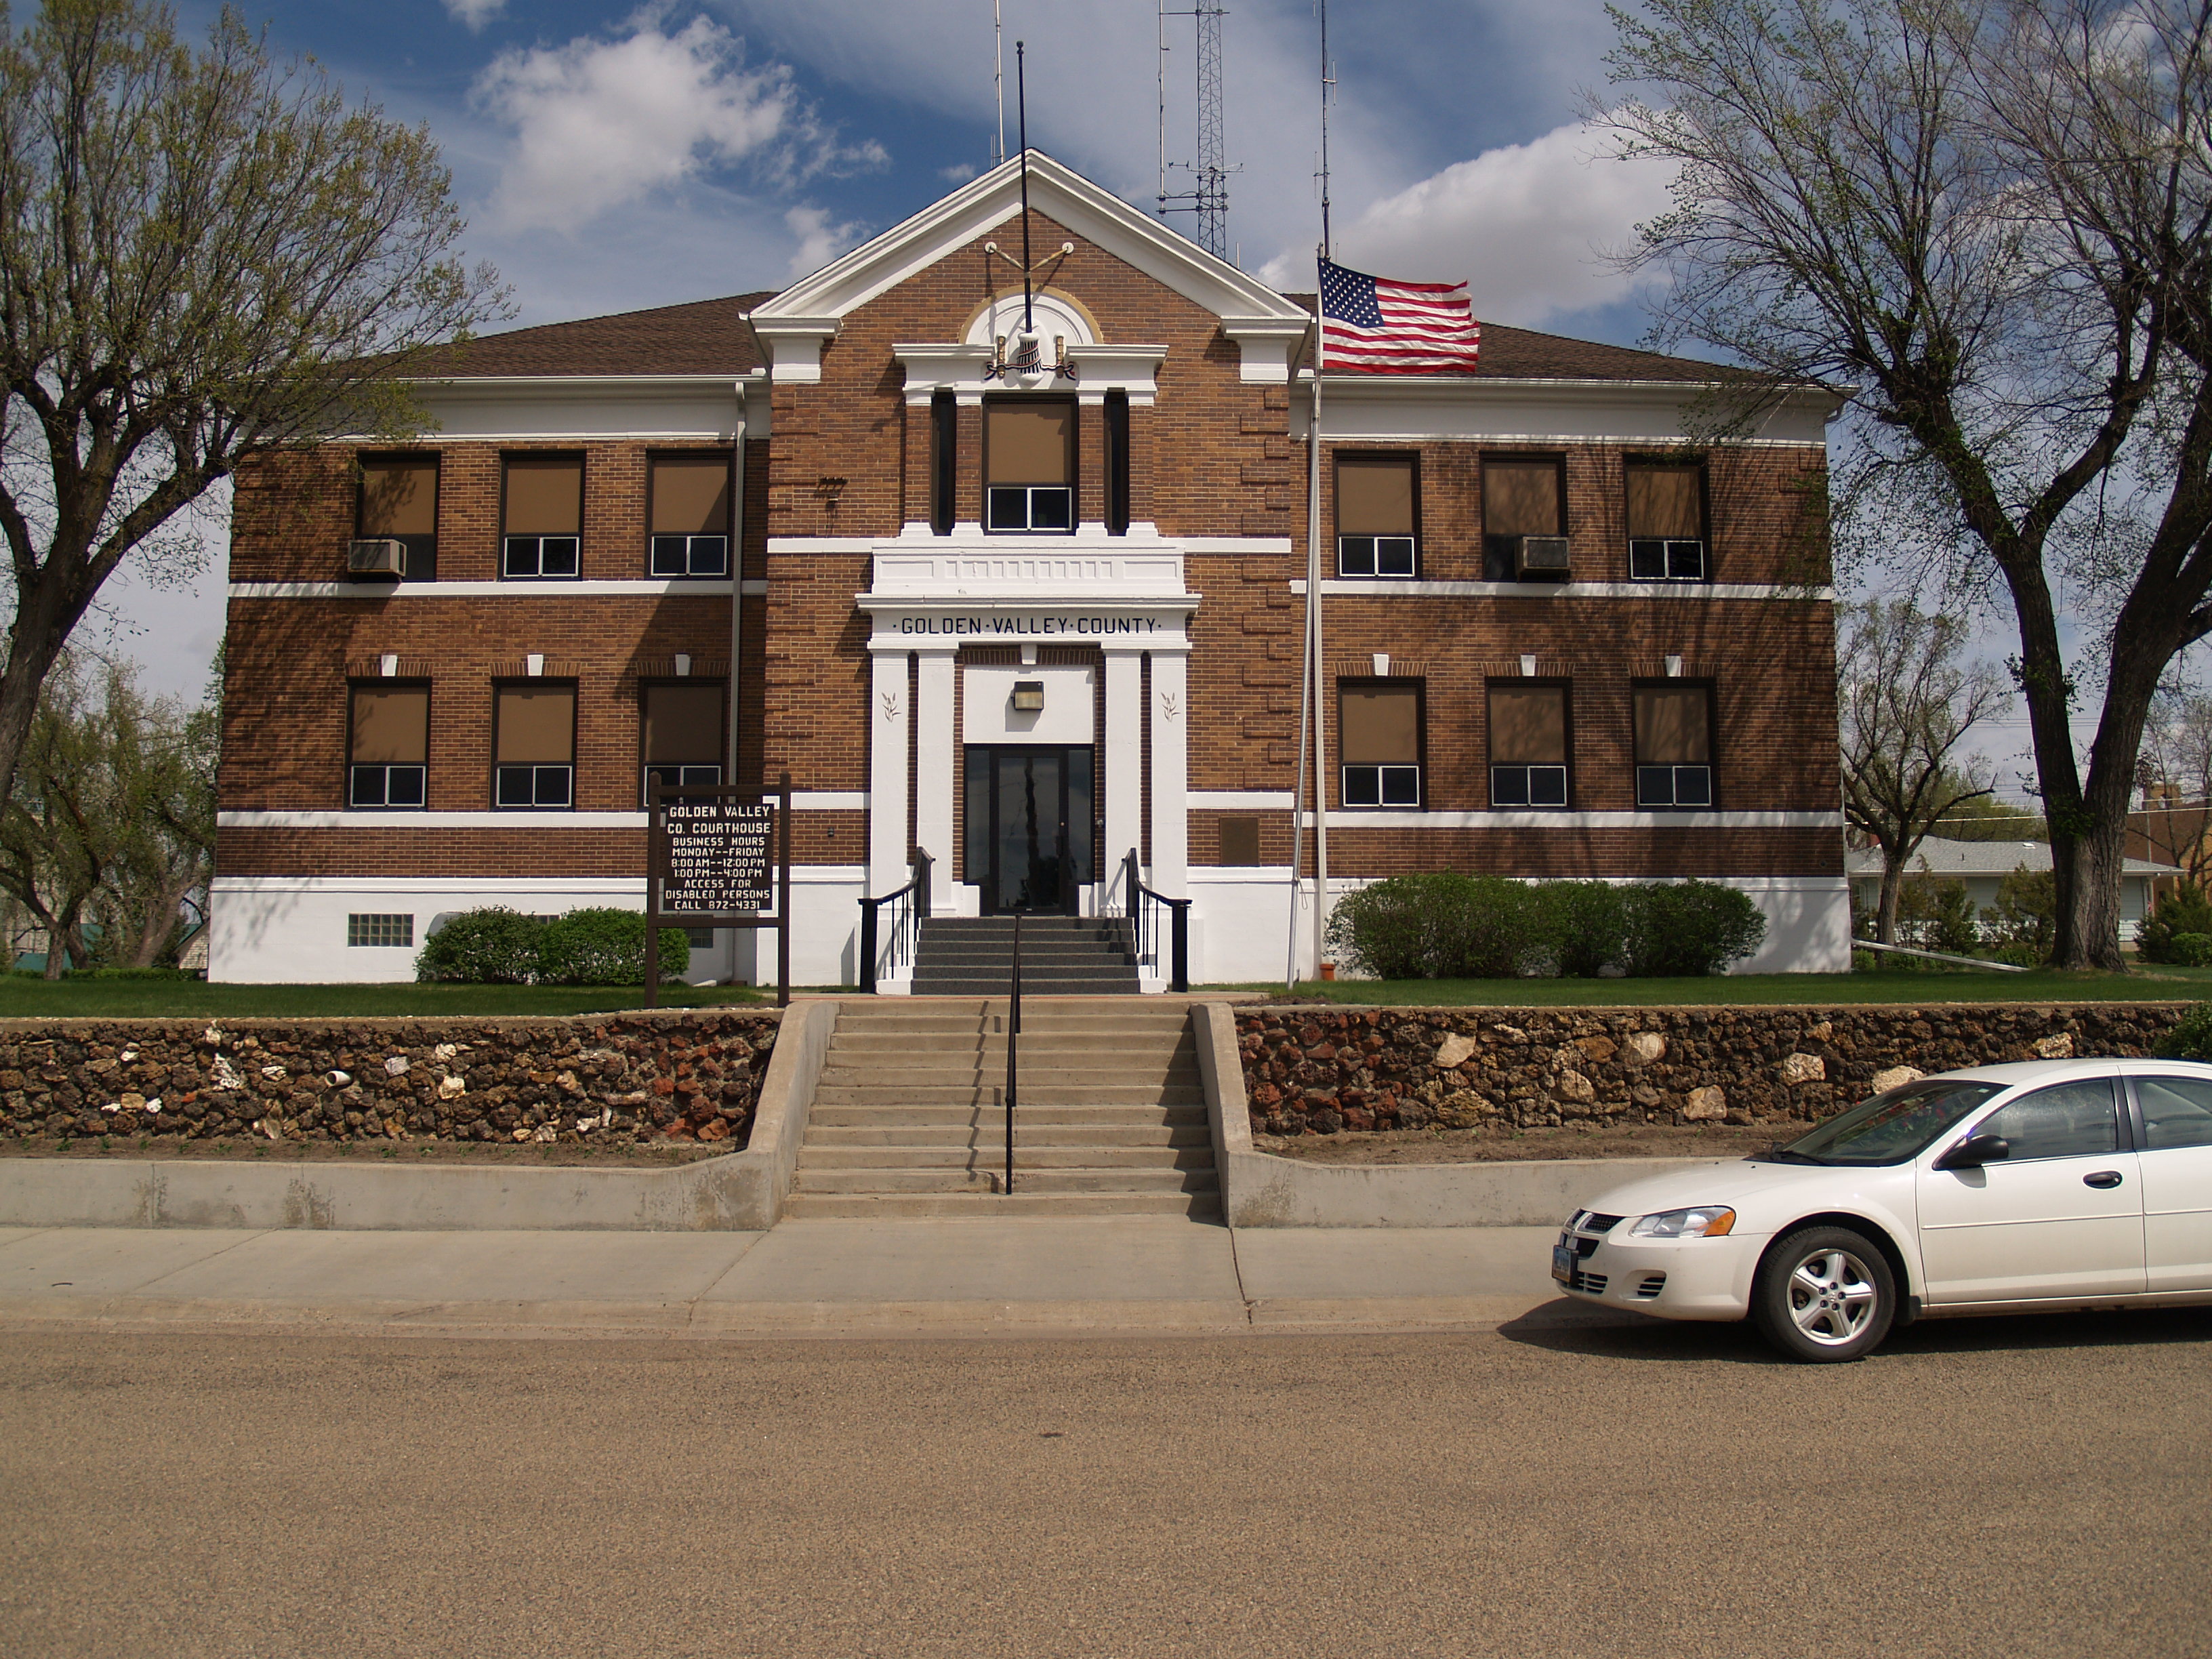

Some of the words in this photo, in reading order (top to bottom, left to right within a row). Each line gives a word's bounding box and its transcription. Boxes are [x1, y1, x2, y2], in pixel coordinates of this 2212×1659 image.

[901, 617, 981, 634] GOLDEN
[992, 617, 1067, 634] VALLEY
[1078, 617, 1155, 634] COUNTY
[670, 806, 716, 817] GOLDEN
[724, 806, 769, 817] VALLEY
[668, 823, 685, 834] CO.
[693, 823, 771, 834] COURTHOUSE
[673, 837, 724, 846] BUSINESS
[731, 837, 765, 846] HOURS
[672, 859, 693, 867] 8:00
[750, 859, 765, 867] PM
[674, 869, 693, 878] 1:00
[747, 869, 762, 877] PM
[684, 880, 724, 888] ACCESS
[731, 880, 752, 888] FOR
[665, 890, 715, 899] DISABLED
[722, 890, 770, 899] PERSONS
[675, 901, 701, 909] CALL
[708, 901, 760, 909] 872-4331
